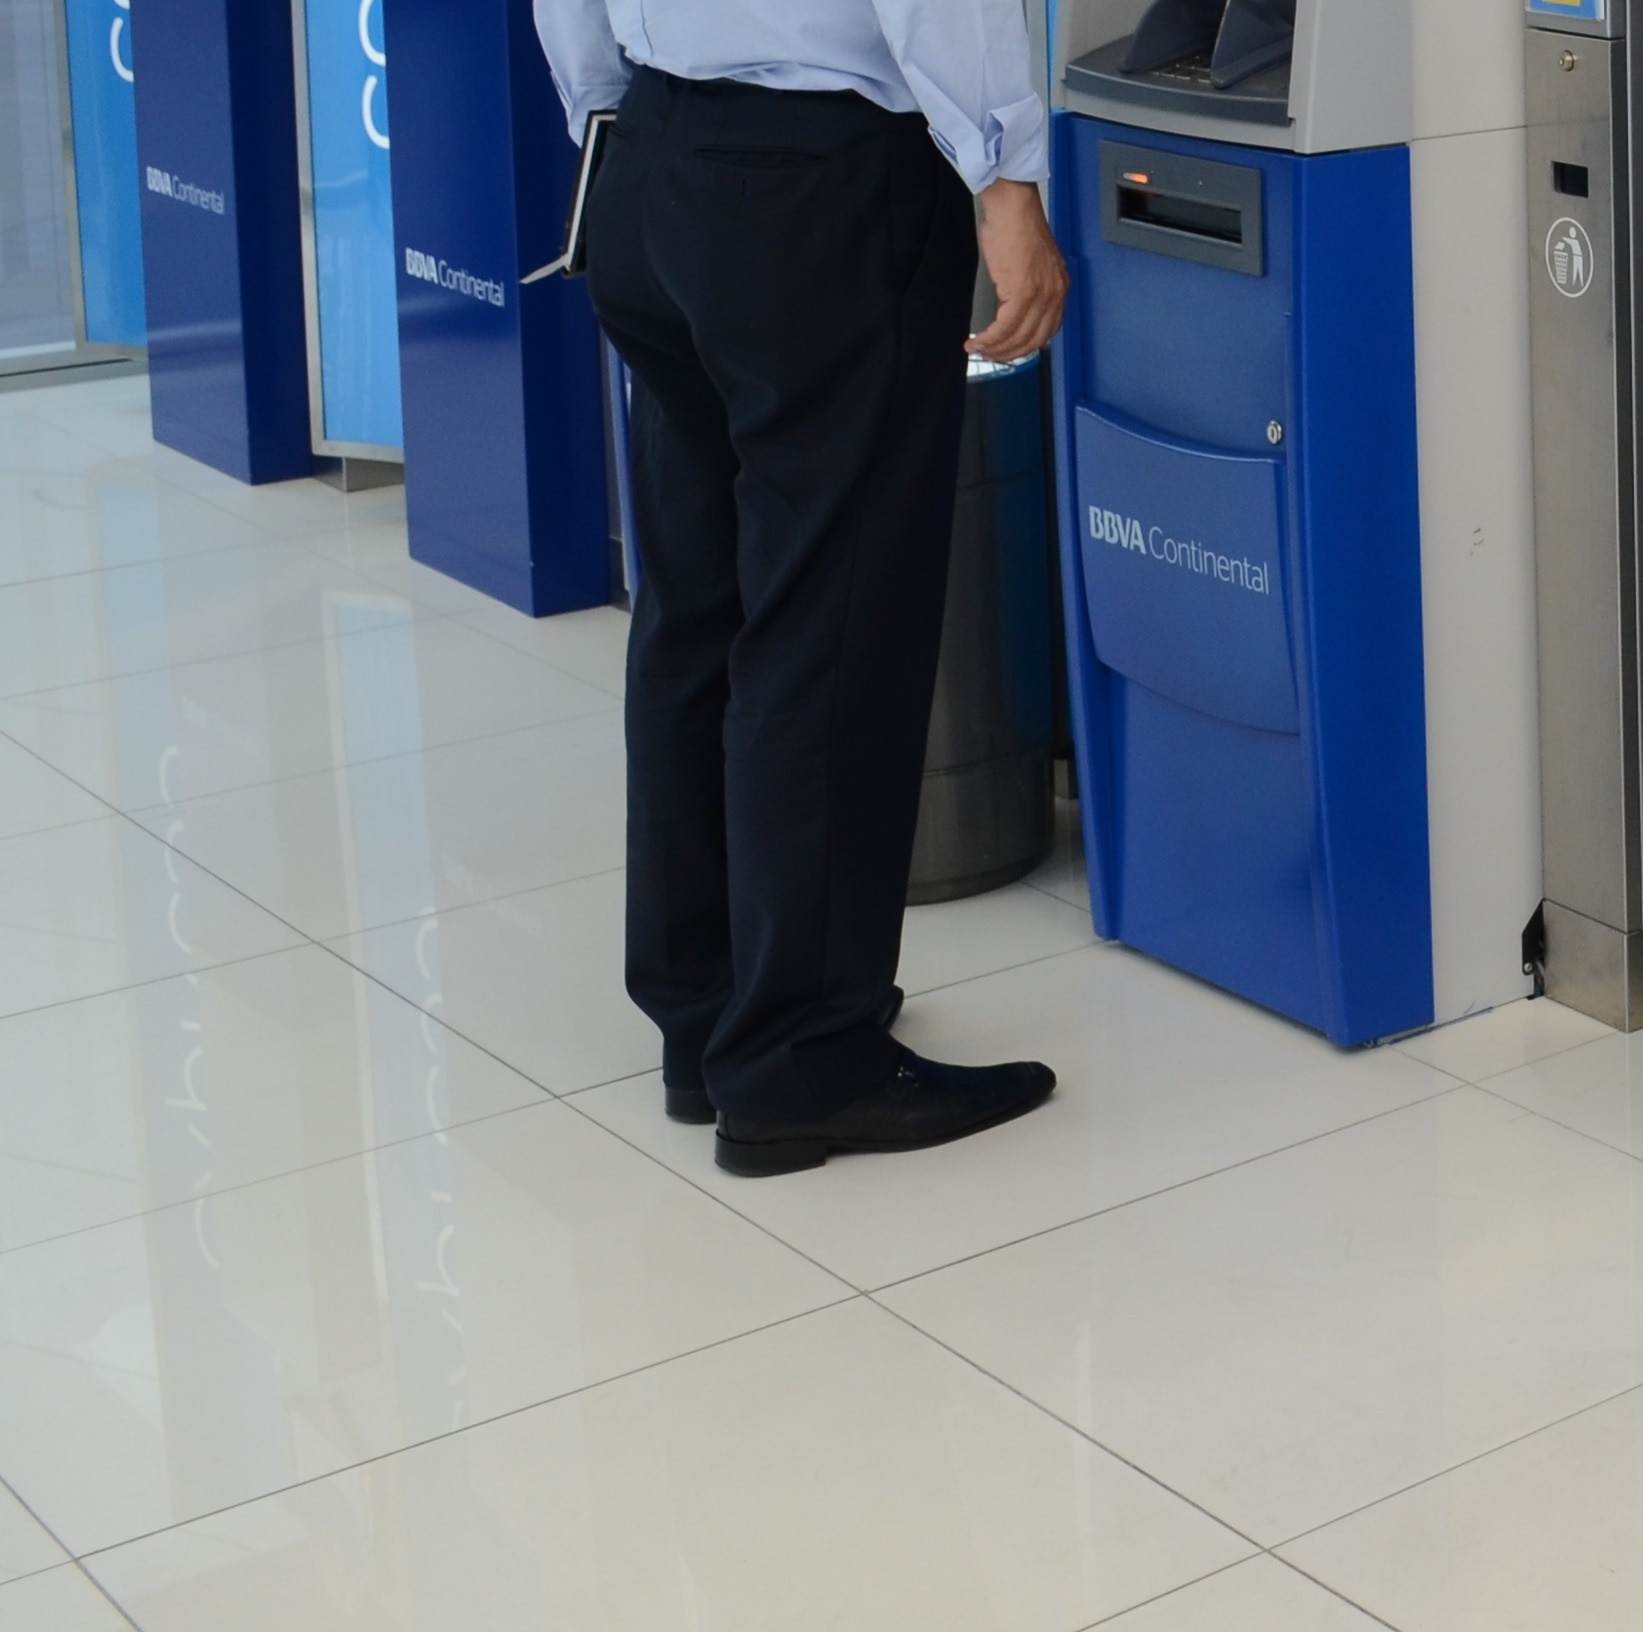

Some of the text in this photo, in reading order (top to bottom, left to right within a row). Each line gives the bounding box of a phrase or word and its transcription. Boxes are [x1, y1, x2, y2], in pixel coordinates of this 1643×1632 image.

[405, 247, 505, 307] BBVA Continental
[1089, 505, 1270, 595] BBVA Continental
